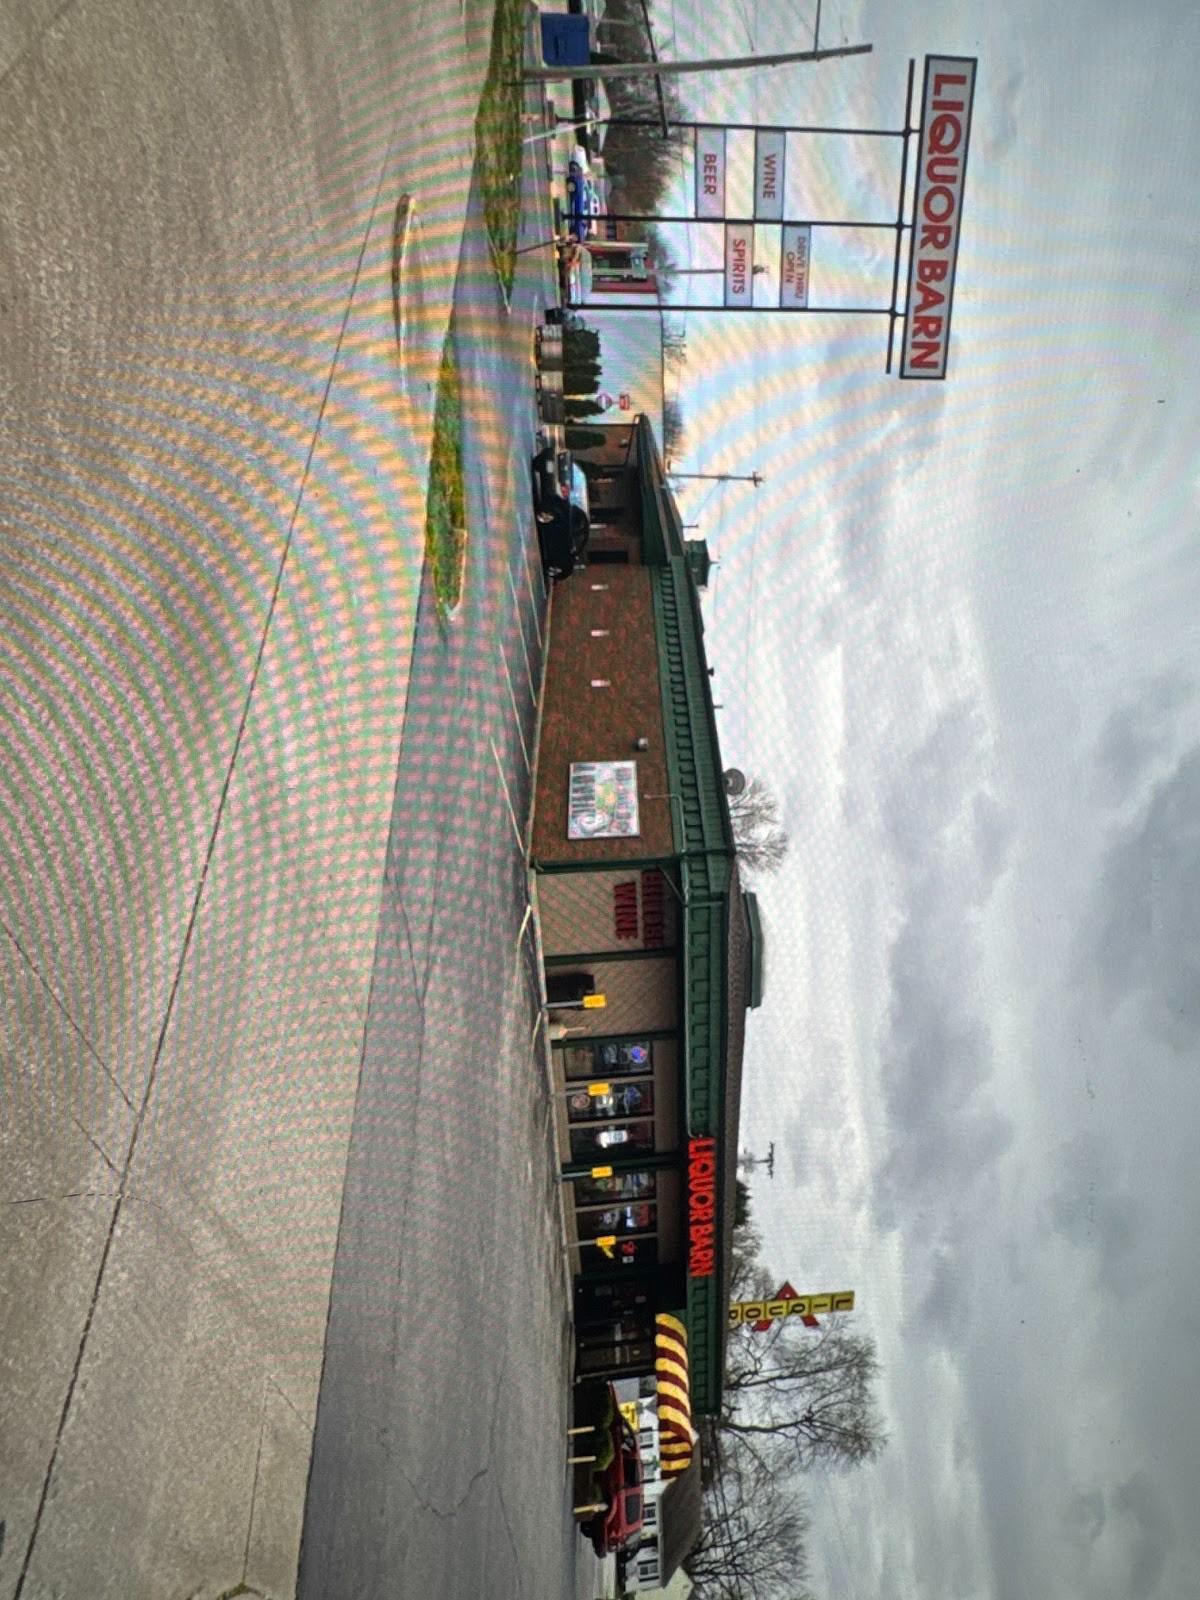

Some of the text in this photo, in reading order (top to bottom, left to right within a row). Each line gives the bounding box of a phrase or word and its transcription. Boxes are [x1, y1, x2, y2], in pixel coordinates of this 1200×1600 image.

[702, 153, 718, 196] BEER
[762, 154, 777, 200] WINE
[910, 74, 968, 369] LIQUOR BARN
[731, 238, 747, 295] SPIRITS
[785, 251, 796, 283] OPEN
[794, 236, 806, 299] DRIVE THRU
[614, 881, 639, 941] WINE
[687, 1138, 717, 1277] LIQUOR BARN
